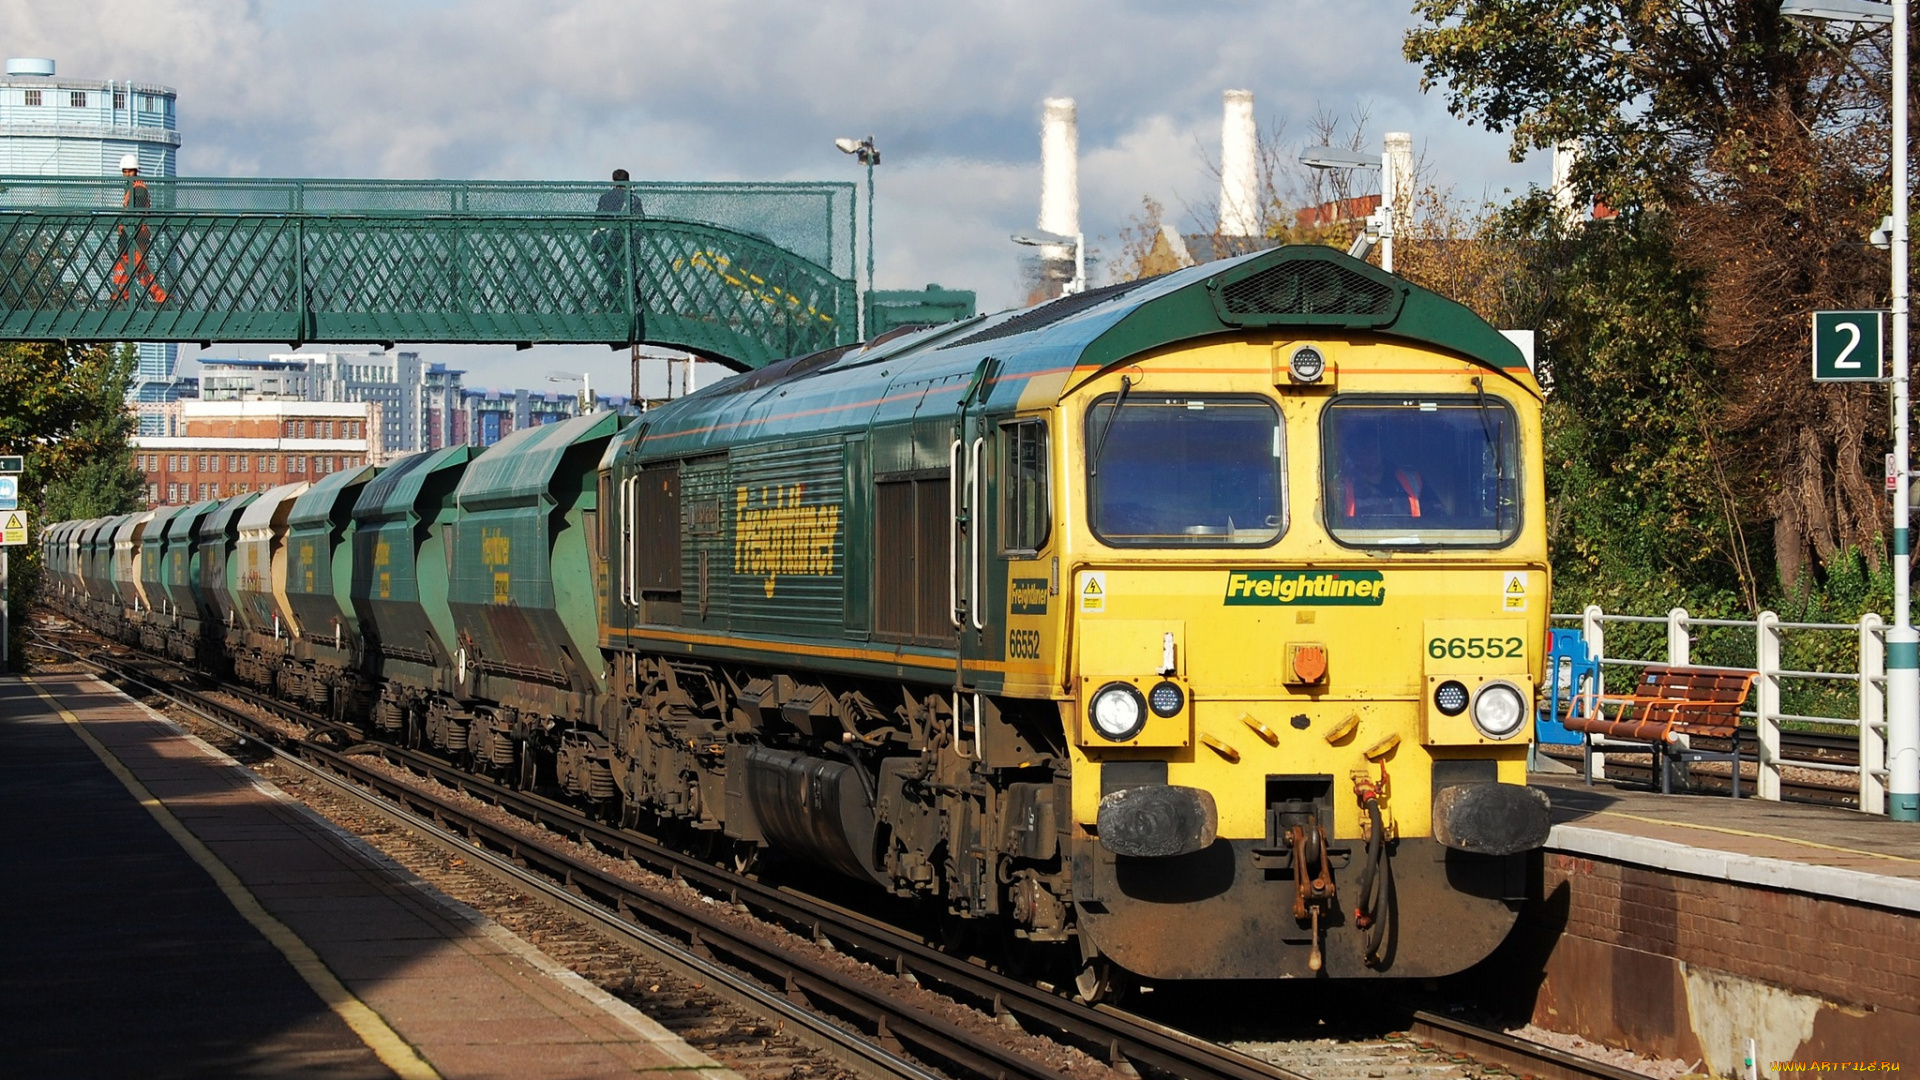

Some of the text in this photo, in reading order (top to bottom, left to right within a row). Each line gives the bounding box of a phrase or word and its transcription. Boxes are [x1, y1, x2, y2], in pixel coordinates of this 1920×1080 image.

[1834, 322, 1861, 369] 2
[735, 483, 839, 599] Freightliner
[1011, 583, 1048, 610] Freightliner
[1228, 574, 1385, 602] Freightliner
[1009, 628, 1041, 659] 66552
[1428, 636, 1524, 660] 66552
